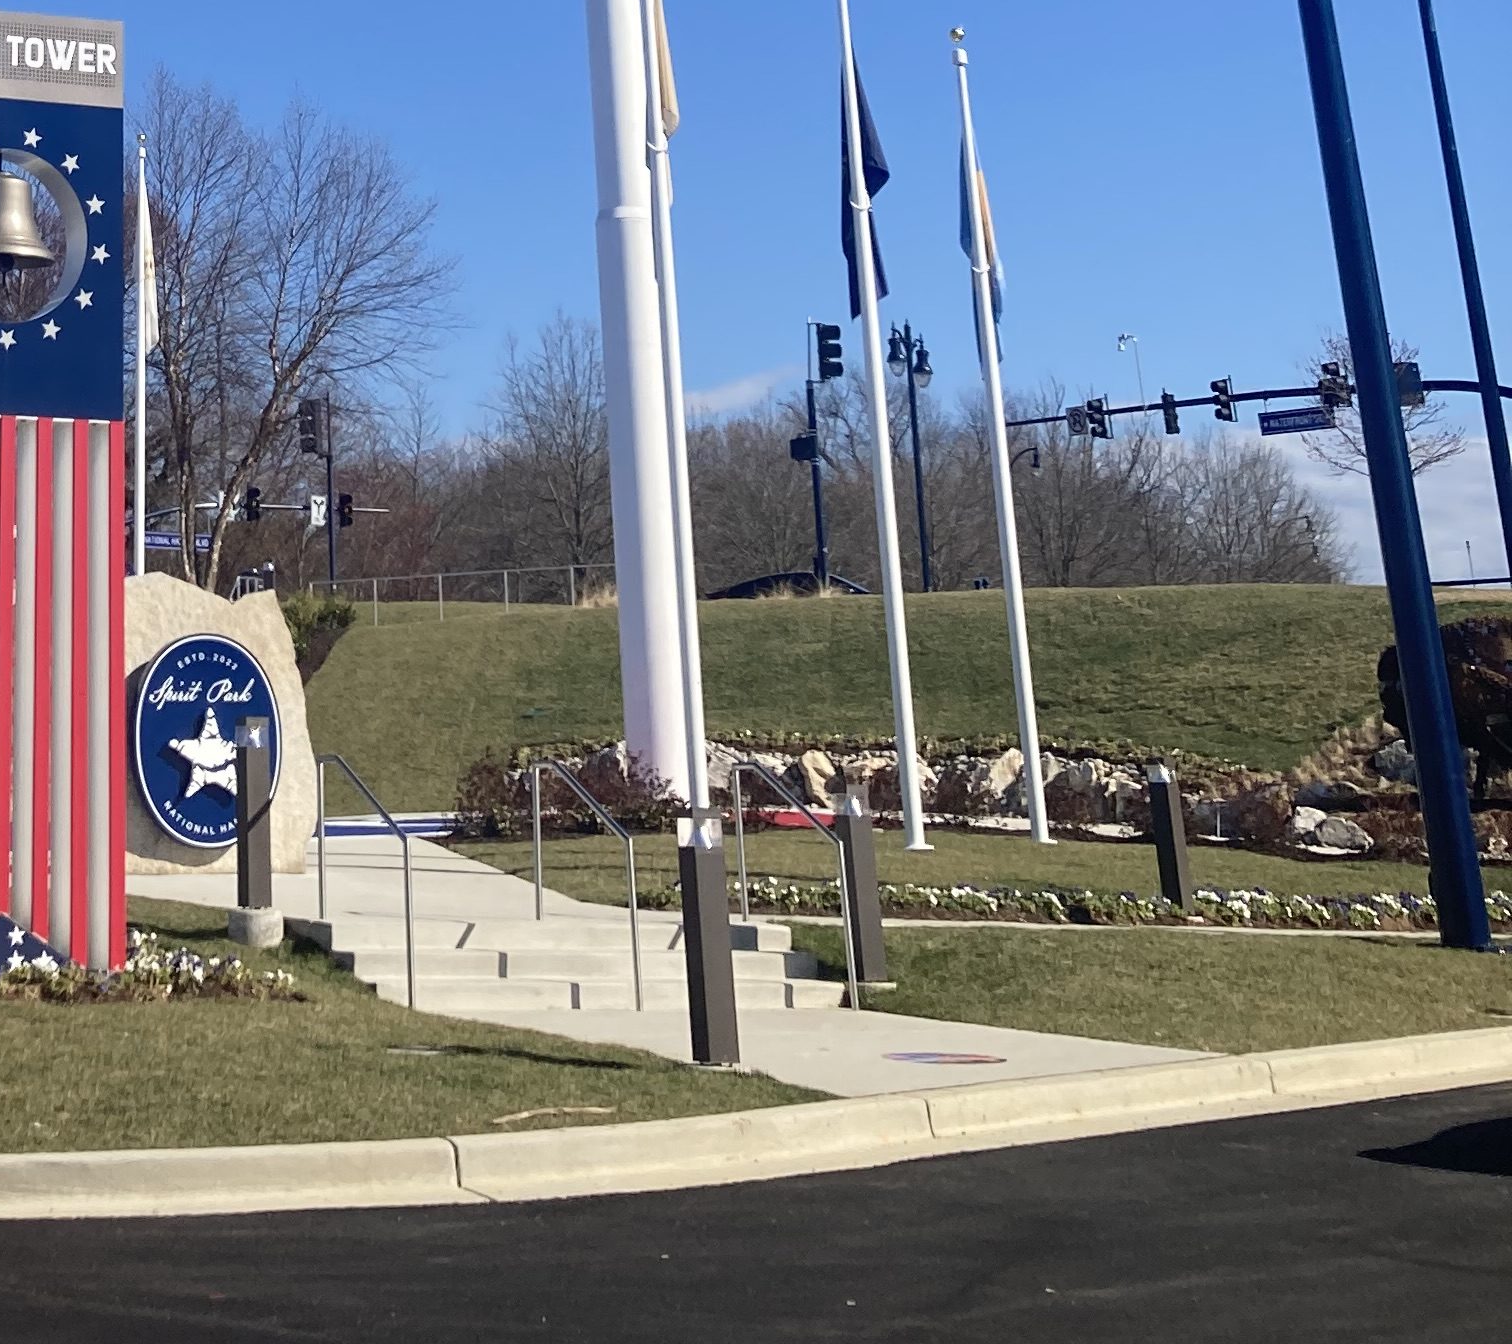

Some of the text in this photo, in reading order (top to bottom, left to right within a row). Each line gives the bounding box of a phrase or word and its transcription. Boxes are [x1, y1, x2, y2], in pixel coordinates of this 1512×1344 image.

[5, 34, 118, 76] TOWER
[148, 675, 255, 711] Spirit Park
[162, 799, 216, 836] NATIONAL
